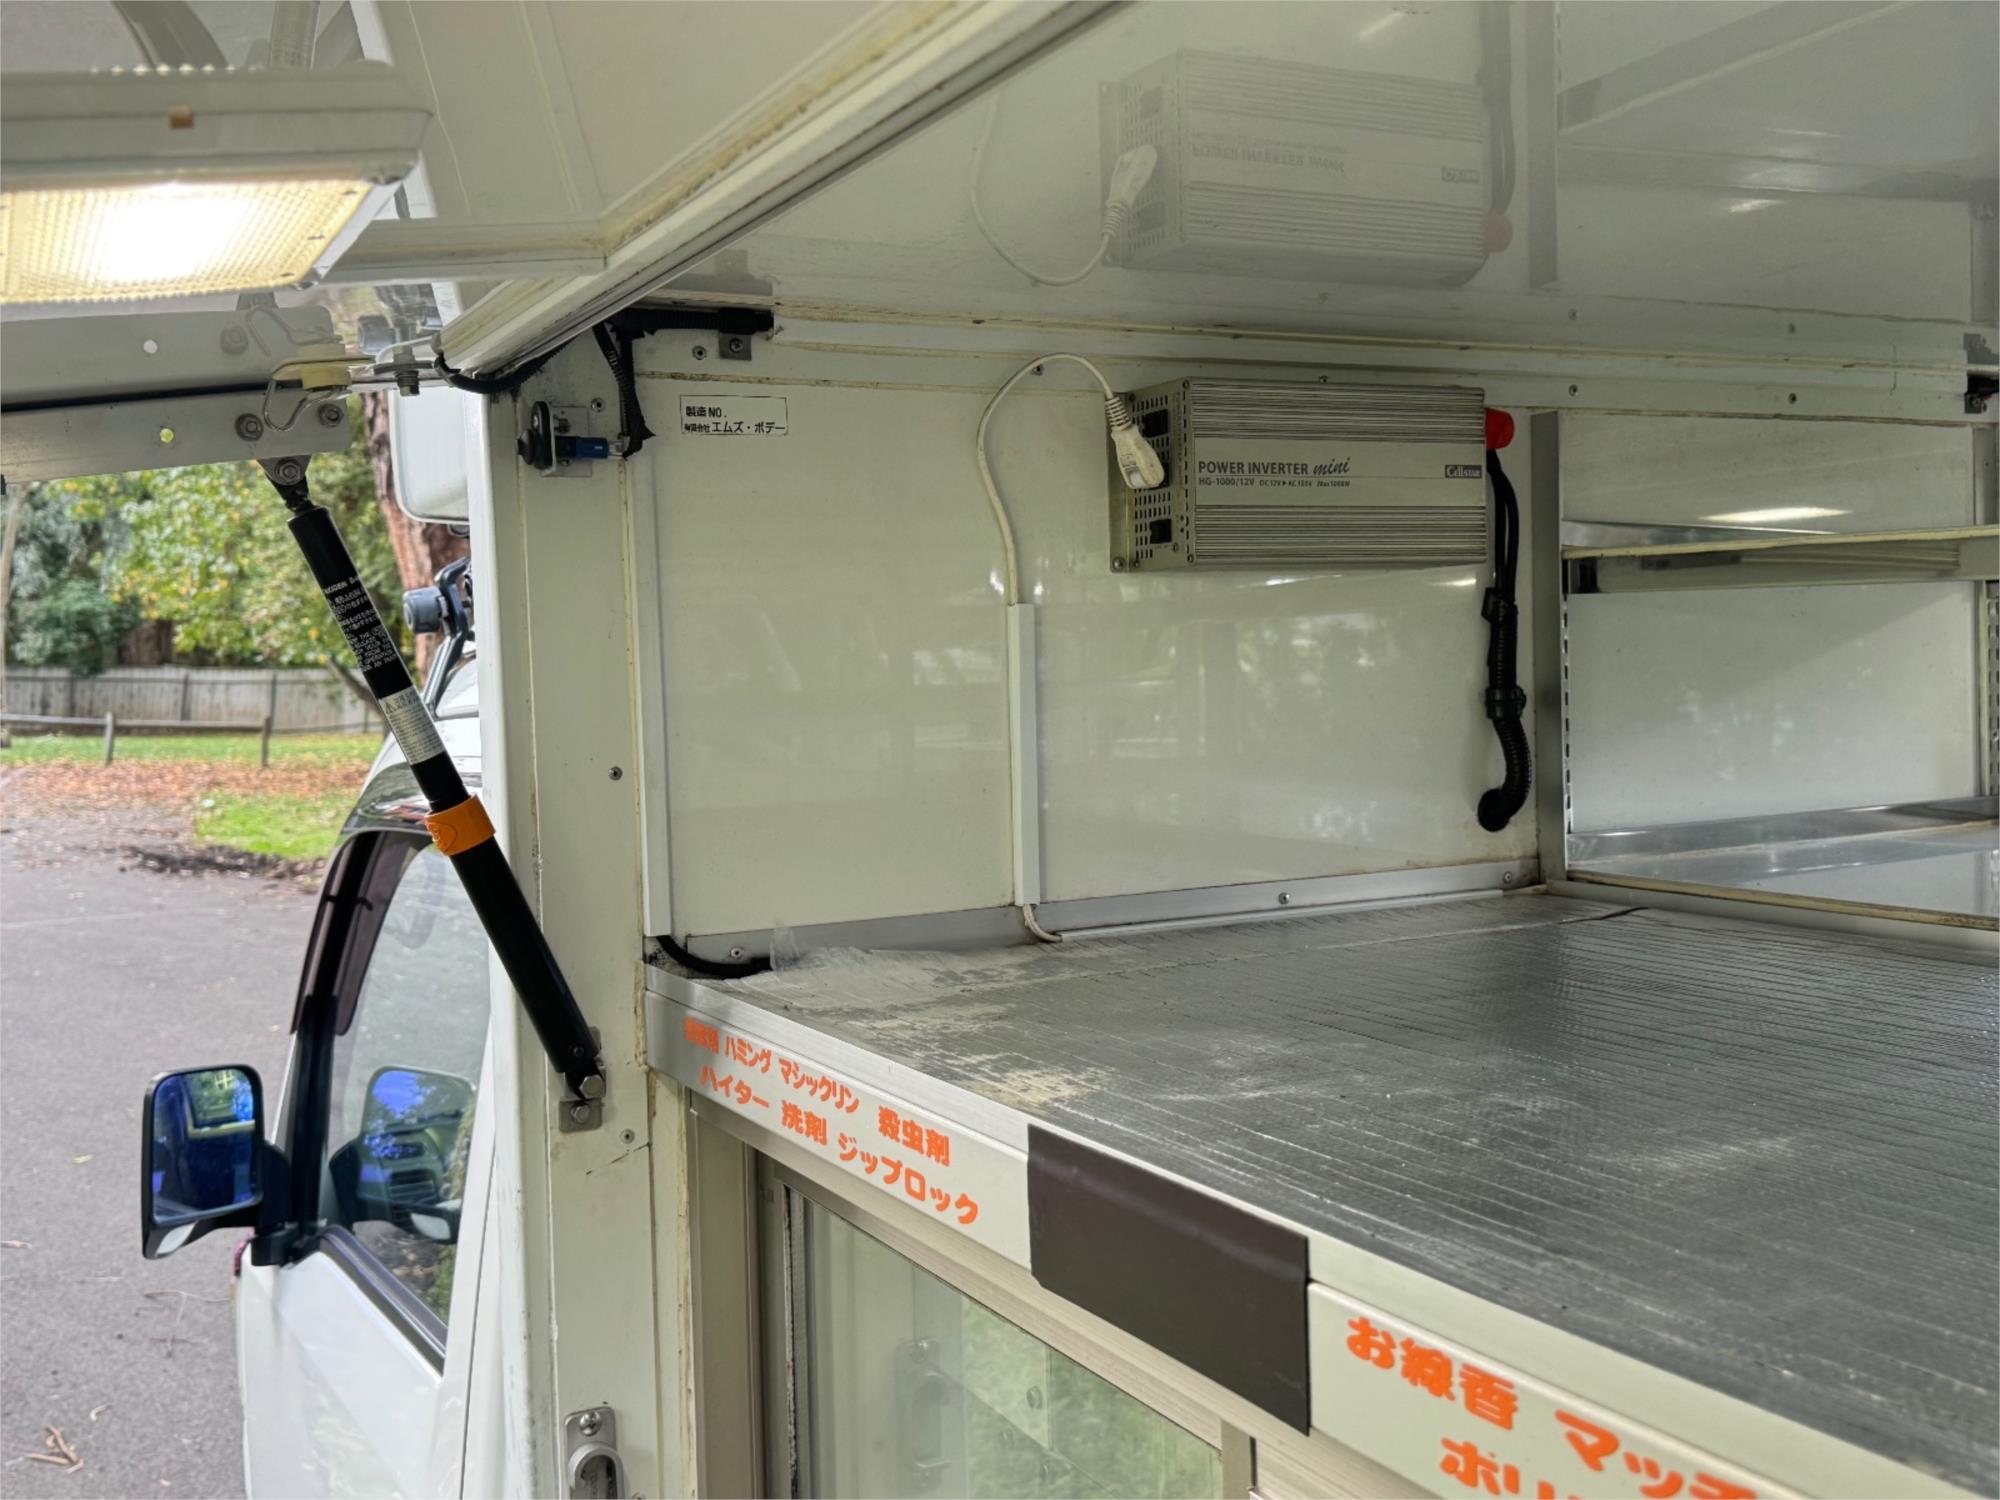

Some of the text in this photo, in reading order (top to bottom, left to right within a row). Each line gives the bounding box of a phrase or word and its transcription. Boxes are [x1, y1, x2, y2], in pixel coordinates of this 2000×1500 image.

[1198, 456, 1351, 476] POWER INVERTER mini
[700, 1065, 979, 1226] ハイター 洗剤 ジップロック
[725, 1034, 773, 1074] ハミング
[877, 1104, 951, 1168] 殺虫剤
